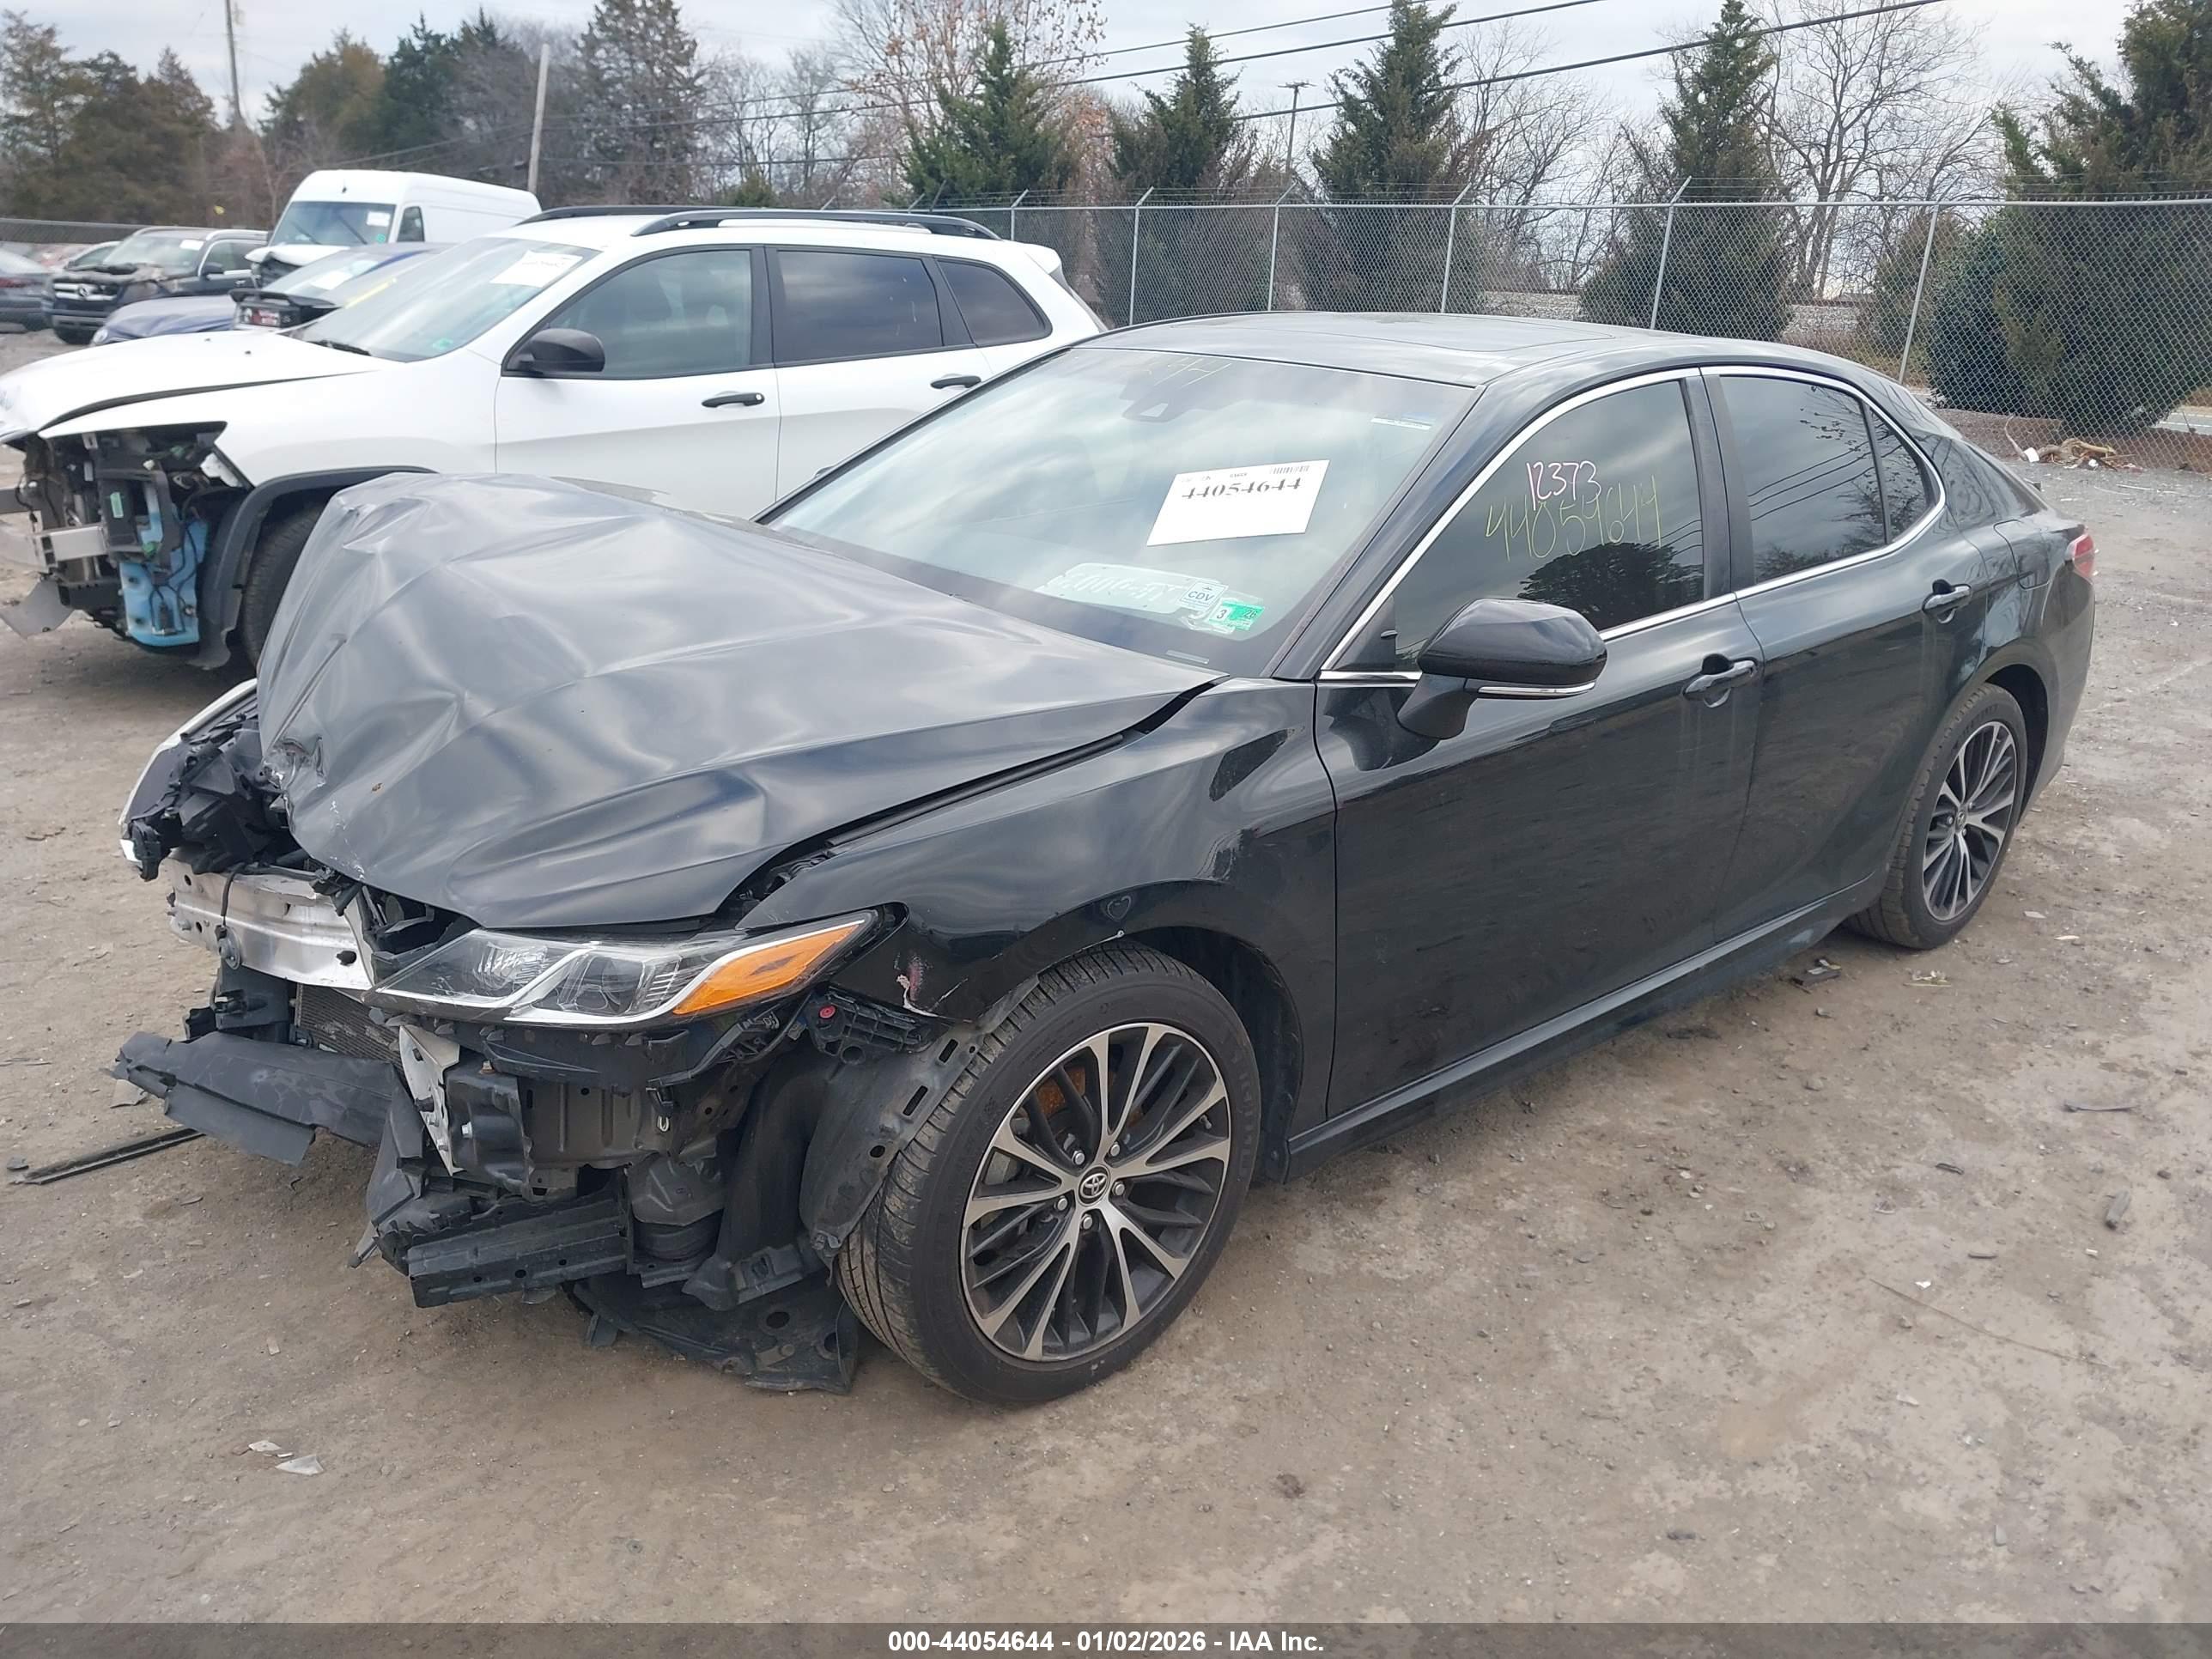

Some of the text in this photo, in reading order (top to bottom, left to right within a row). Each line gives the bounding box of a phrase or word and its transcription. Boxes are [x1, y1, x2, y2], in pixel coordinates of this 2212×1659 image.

[1181, 477, 1302, 500] 44054644
[1526, 460, 1601, 511] 12373
[1486, 474, 1662, 562] 44054644
[1188, 591, 1215, 601] CDV
[1216, 609, 1228, 619] 3
